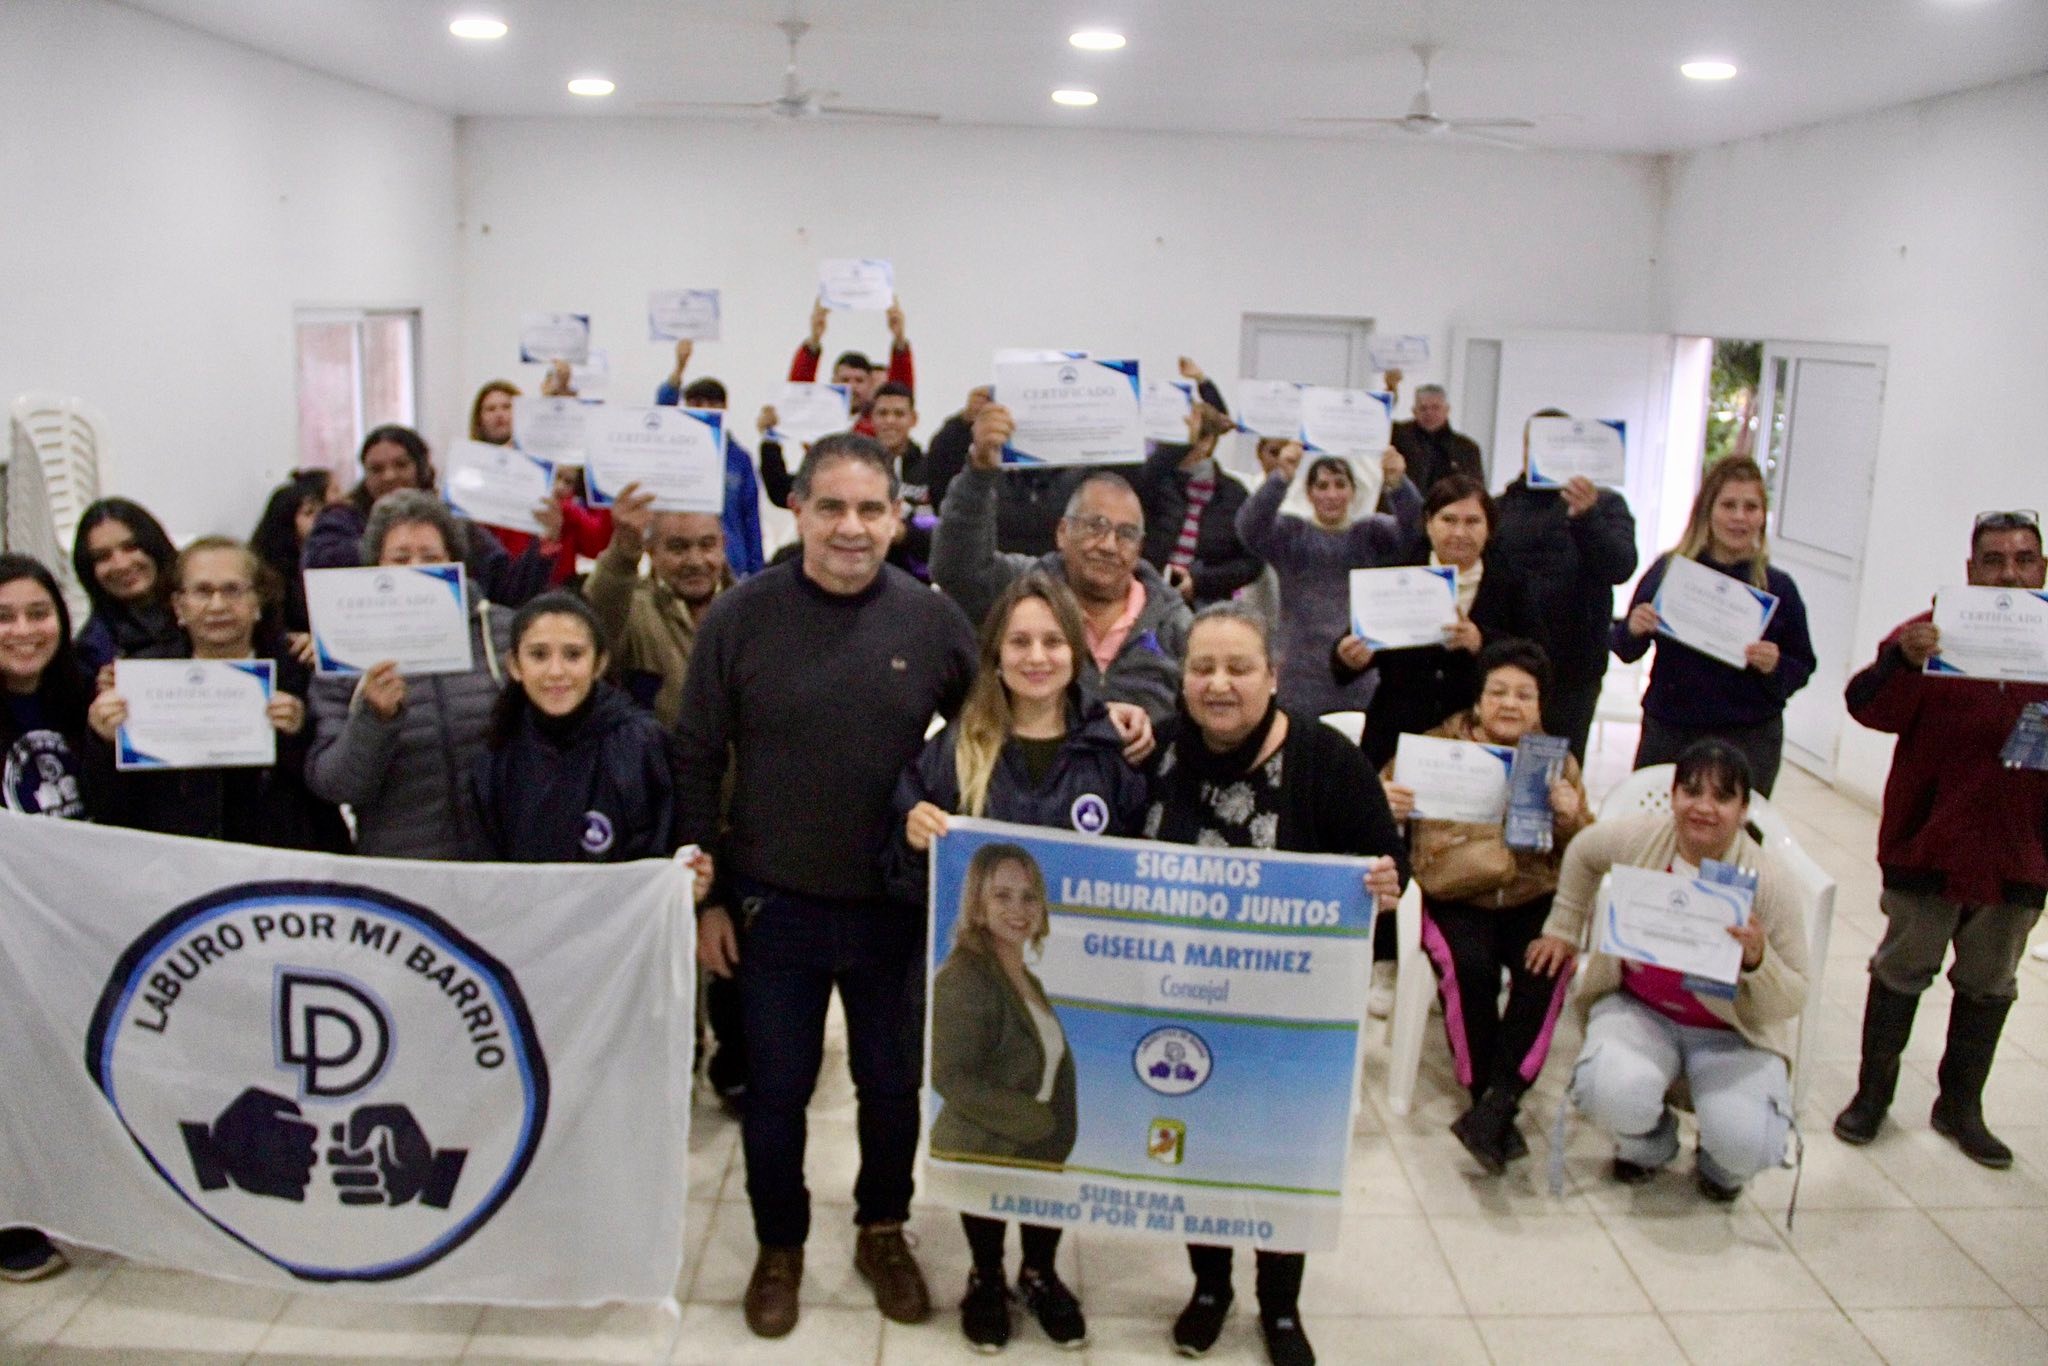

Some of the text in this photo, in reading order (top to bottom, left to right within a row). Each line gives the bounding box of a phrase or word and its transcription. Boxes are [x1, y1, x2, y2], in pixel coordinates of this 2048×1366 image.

[1136, 851, 1262, 888] SIGAMOS
[1061, 876, 1341, 926] LABURANDO JUNTOS
[1083, 932, 1312, 974] GISELLA MARTINEZ
[135, 912, 506, 1070] LABURO POR MI BARRIO
[1160, 973, 1231, 1005] Concejal
[990, 1192, 1274, 1239] LABURO POR MI BARRIO
[1079, 1183, 1186, 1214] SUBLEMA
